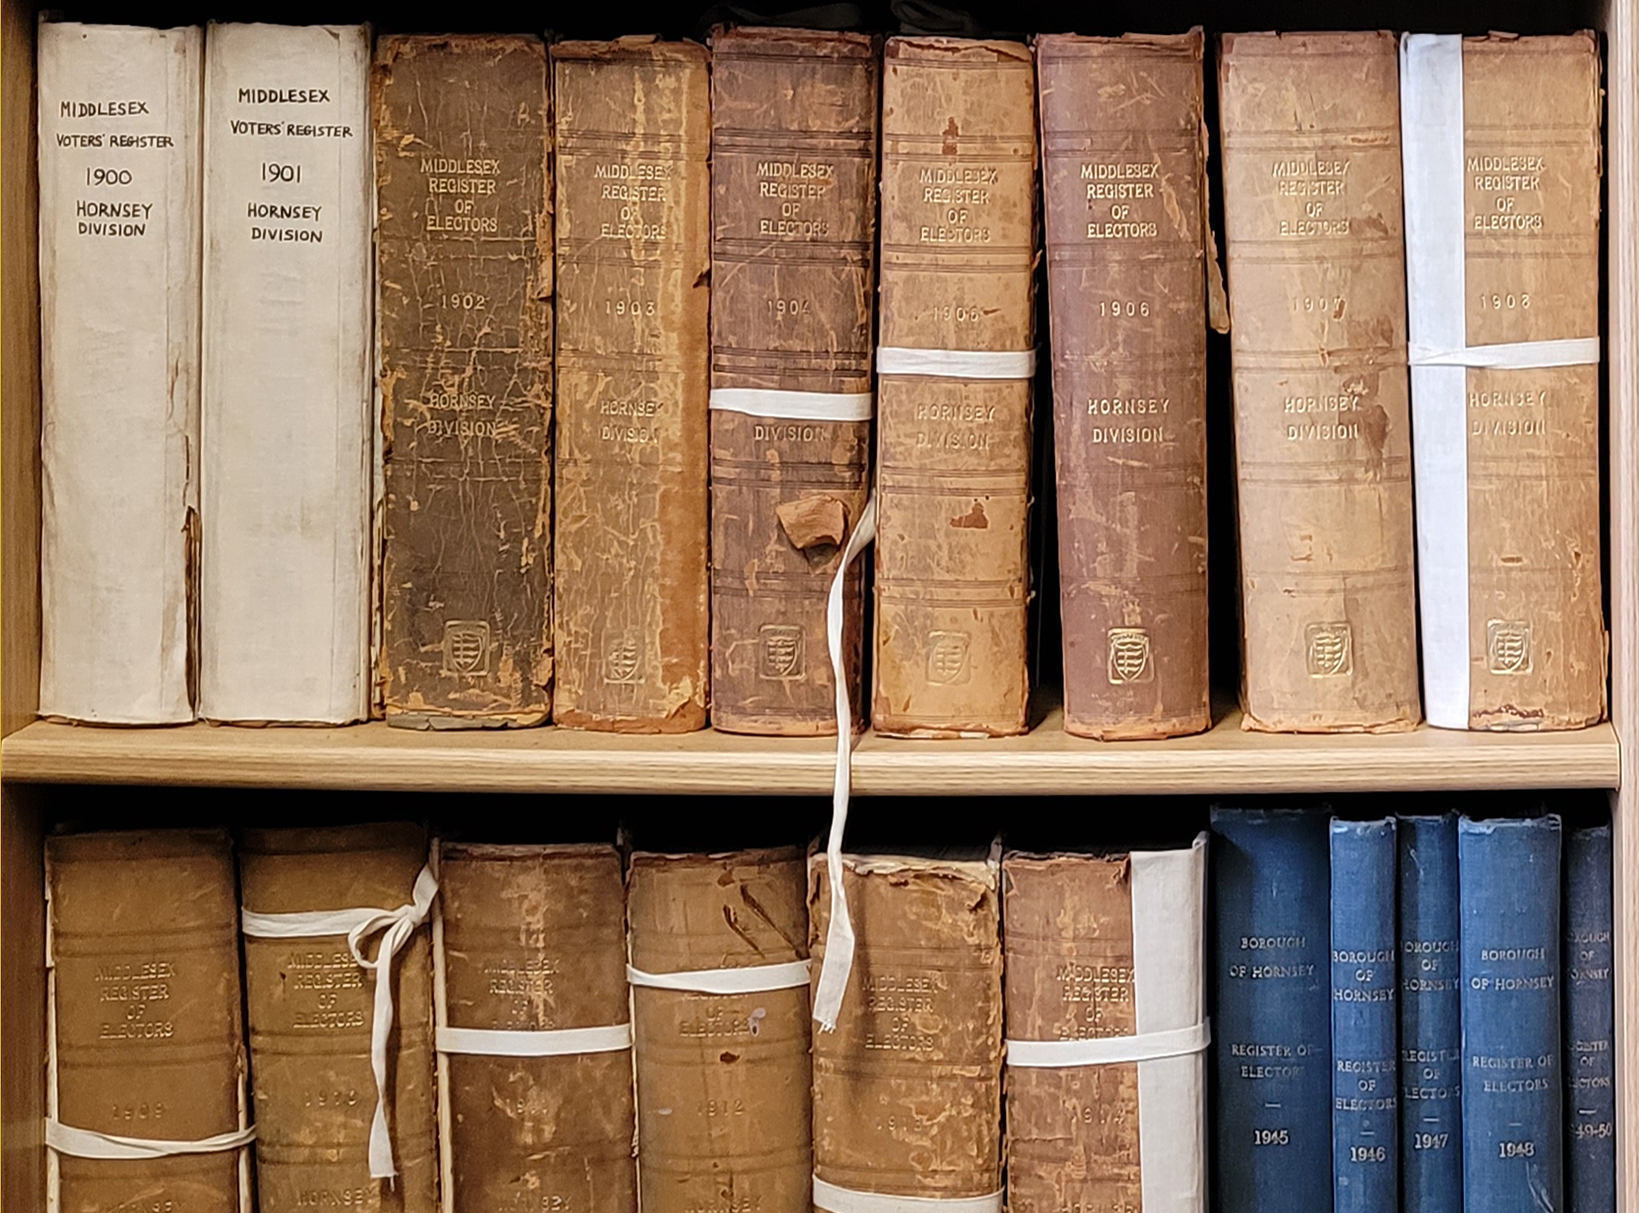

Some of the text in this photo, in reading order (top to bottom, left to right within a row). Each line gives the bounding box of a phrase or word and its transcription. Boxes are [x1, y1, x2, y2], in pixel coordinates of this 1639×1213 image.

[237, 87, 331, 104] MIDDLESEX
[60, 101, 149, 118] MIDDLESEX
[286, 123, 353, 139] REGISTER
[109, 134, 174, 148] REGISTER
[261, 162, 301, 184] 1901
[420, 158, 501, 176] MIDDLESEX
[1079, 162, 1159, 180] MIDDLESEX
[86, 167, 133, 186] 1900
[428, 177, 497, 194] REGISTER
[1086, 183, 1154, 200] REGISTER
[76, 199, 153, 220] HORNSEY
[247, 202, 322, 222] HORNSEY
[454, 199, 474, 214] OF
[1111, 204, 1130, 220] OF
[77, 221, 146, 237] DIVISION
[425, 216, 498, 232] ELECTORS
[1086, 222, 1158, 239] ELECTORS
[251, 226, 323, 243] DIVISION
[441, 293, 485, 311] 1902
[1099, 301, 1150, 318] 1906
[1086, 398, 1170, 416] HORNSEY
[1092, 427, 1164, 444] DIVISION
[1240, 936, 1306, 951] BOROUGH
[1480, 947, 1546, 963] BOROUGH
[1229, 964, 1315, 979] OF HORNSEY
[1355, 969, 1374, 982] OF
[1471, 976, 1555, 991] OF HORNSEY
[1333, 987, 1395, 1002] HORNSEY
[1231, 1043, 1292, 1059] REGISTER
[1336, 1059, 1397, 1074] REGISTER
[1471, 1055, 1533, 1070] REGISTER
[1358, 1078, 1376, 1092] OF
[1483, 1077, 1549, 1093] ELECTORS
[1335, 1096, 1397, 1111] ELECTORS
[1253, 1128, 1290, 1146] 1945
[1349, 1145, 1387, 1163] 1946
[1498, 1141, 1536, 1158] 1948
